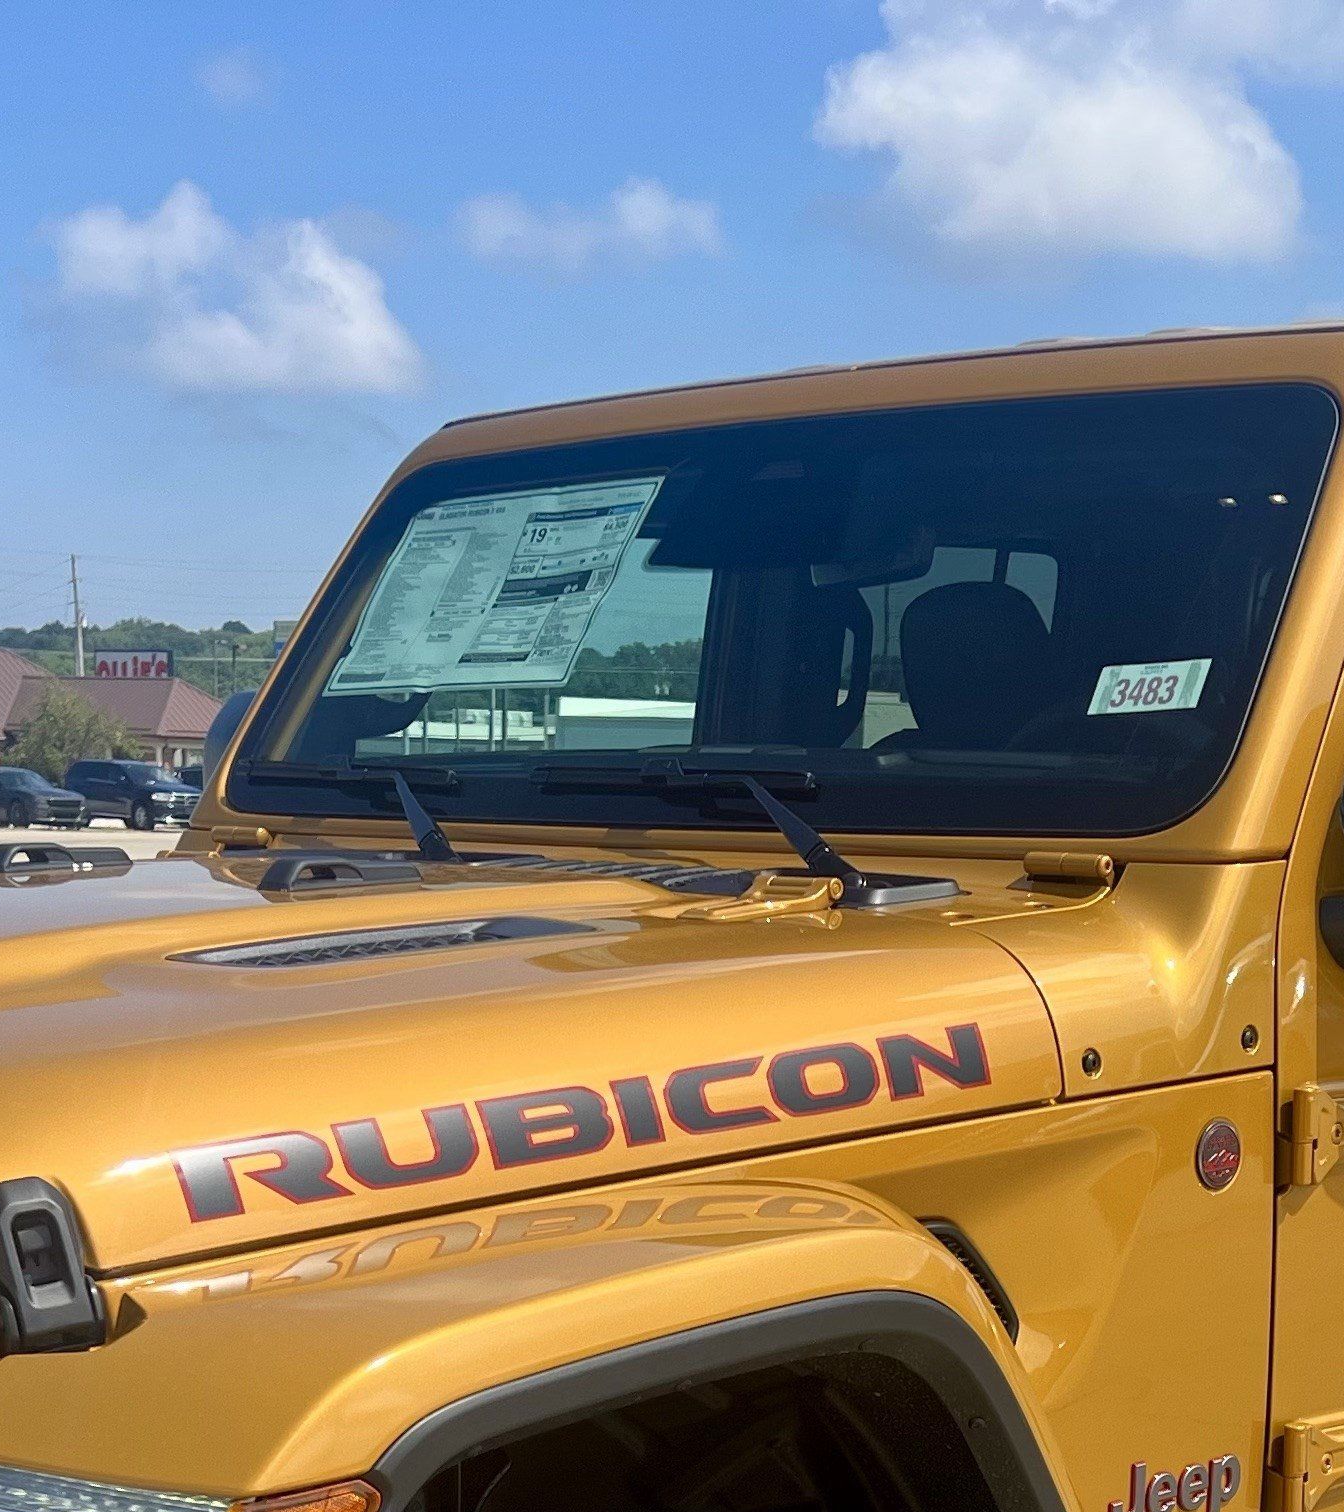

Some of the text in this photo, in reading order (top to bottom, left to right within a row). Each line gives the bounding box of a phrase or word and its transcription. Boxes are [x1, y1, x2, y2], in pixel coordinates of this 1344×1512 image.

[529, 527, 548, 543] 19
[1109, 675, 1180, 709] 3483
[171, 1022, 993, 1223] RUBICON
